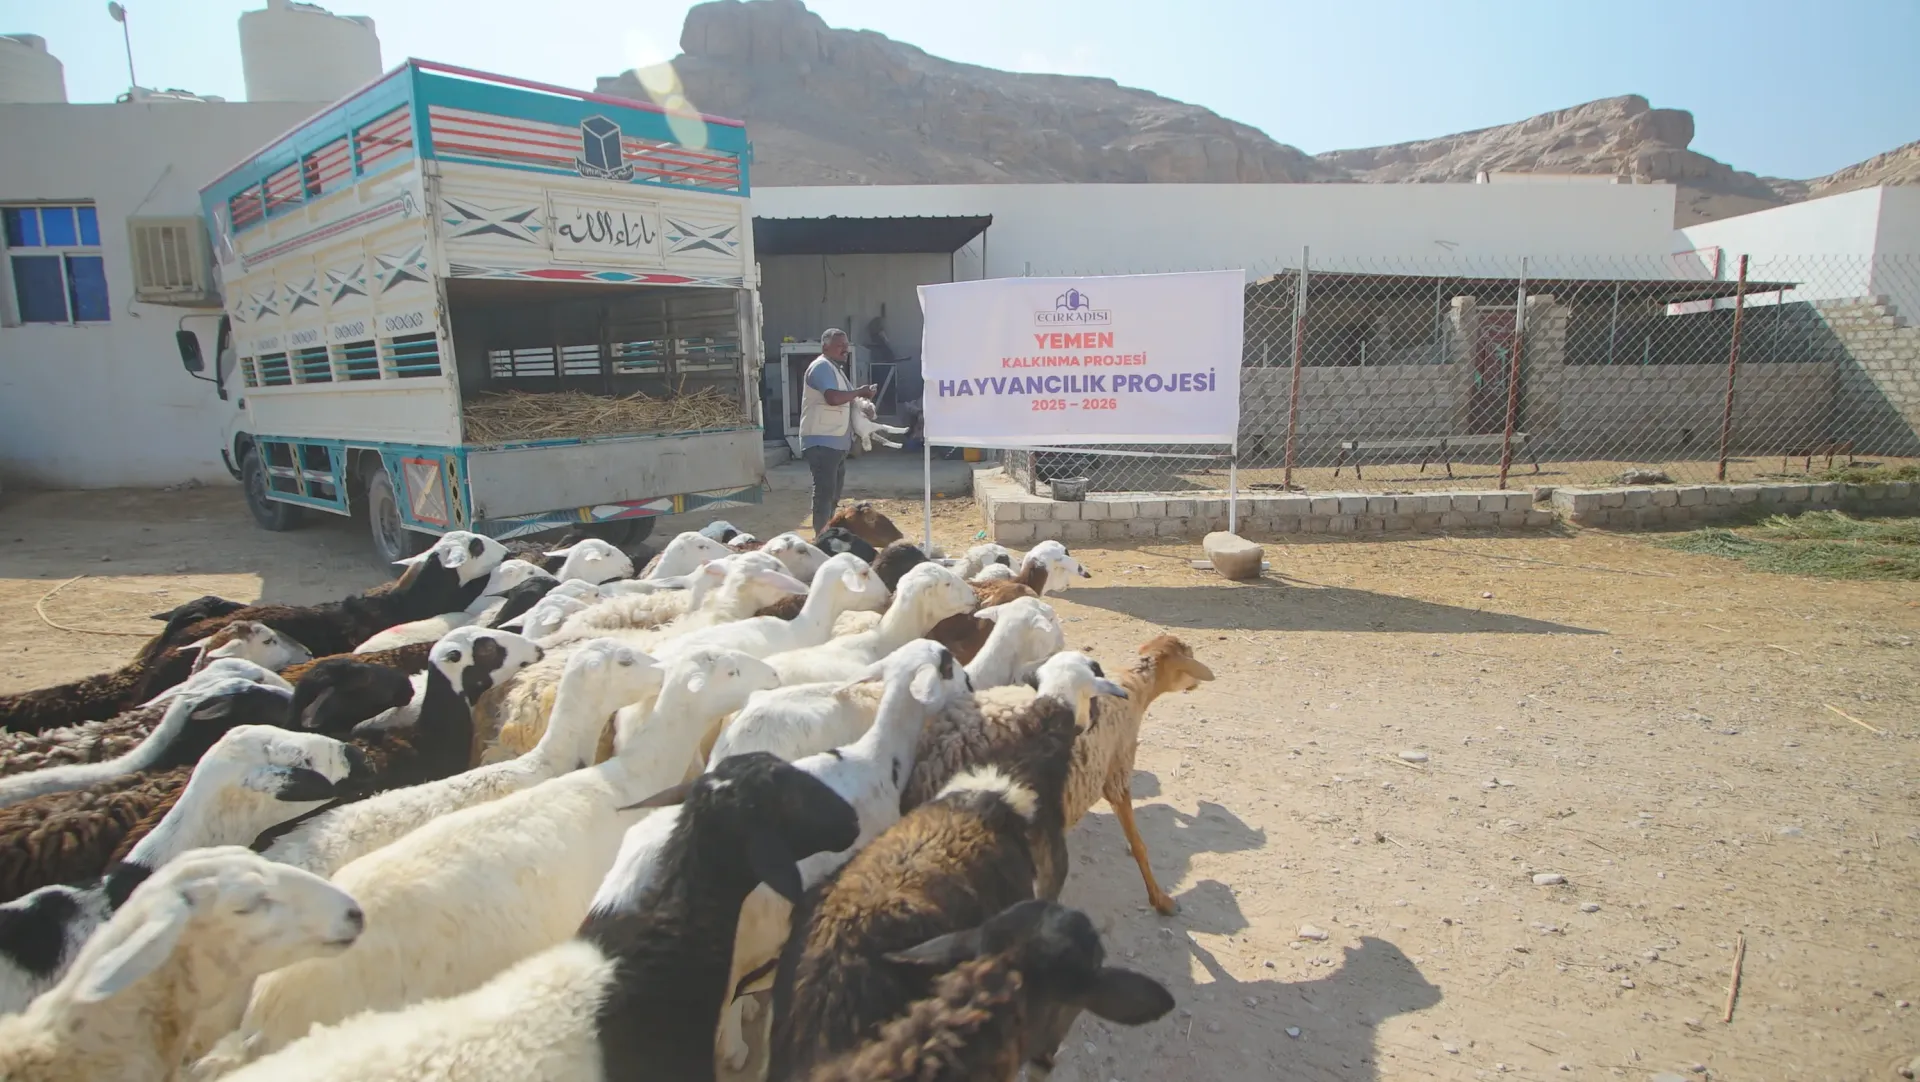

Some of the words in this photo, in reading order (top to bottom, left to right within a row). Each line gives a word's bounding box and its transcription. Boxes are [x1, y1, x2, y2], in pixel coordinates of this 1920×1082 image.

[1034, 332, 1114, 349] YEMEN
[1002, 356, 1080, 368] KALKINMA
[1084, 351, 1147, 367] PROJESİ
[939, 374, 1107, 397] HAYVANCILIK
[1112, 367, 1216, 393] PROJESİ
[1031, 399, 1066, 411] 2025
[1082, 398, 1117, 410] 2026
